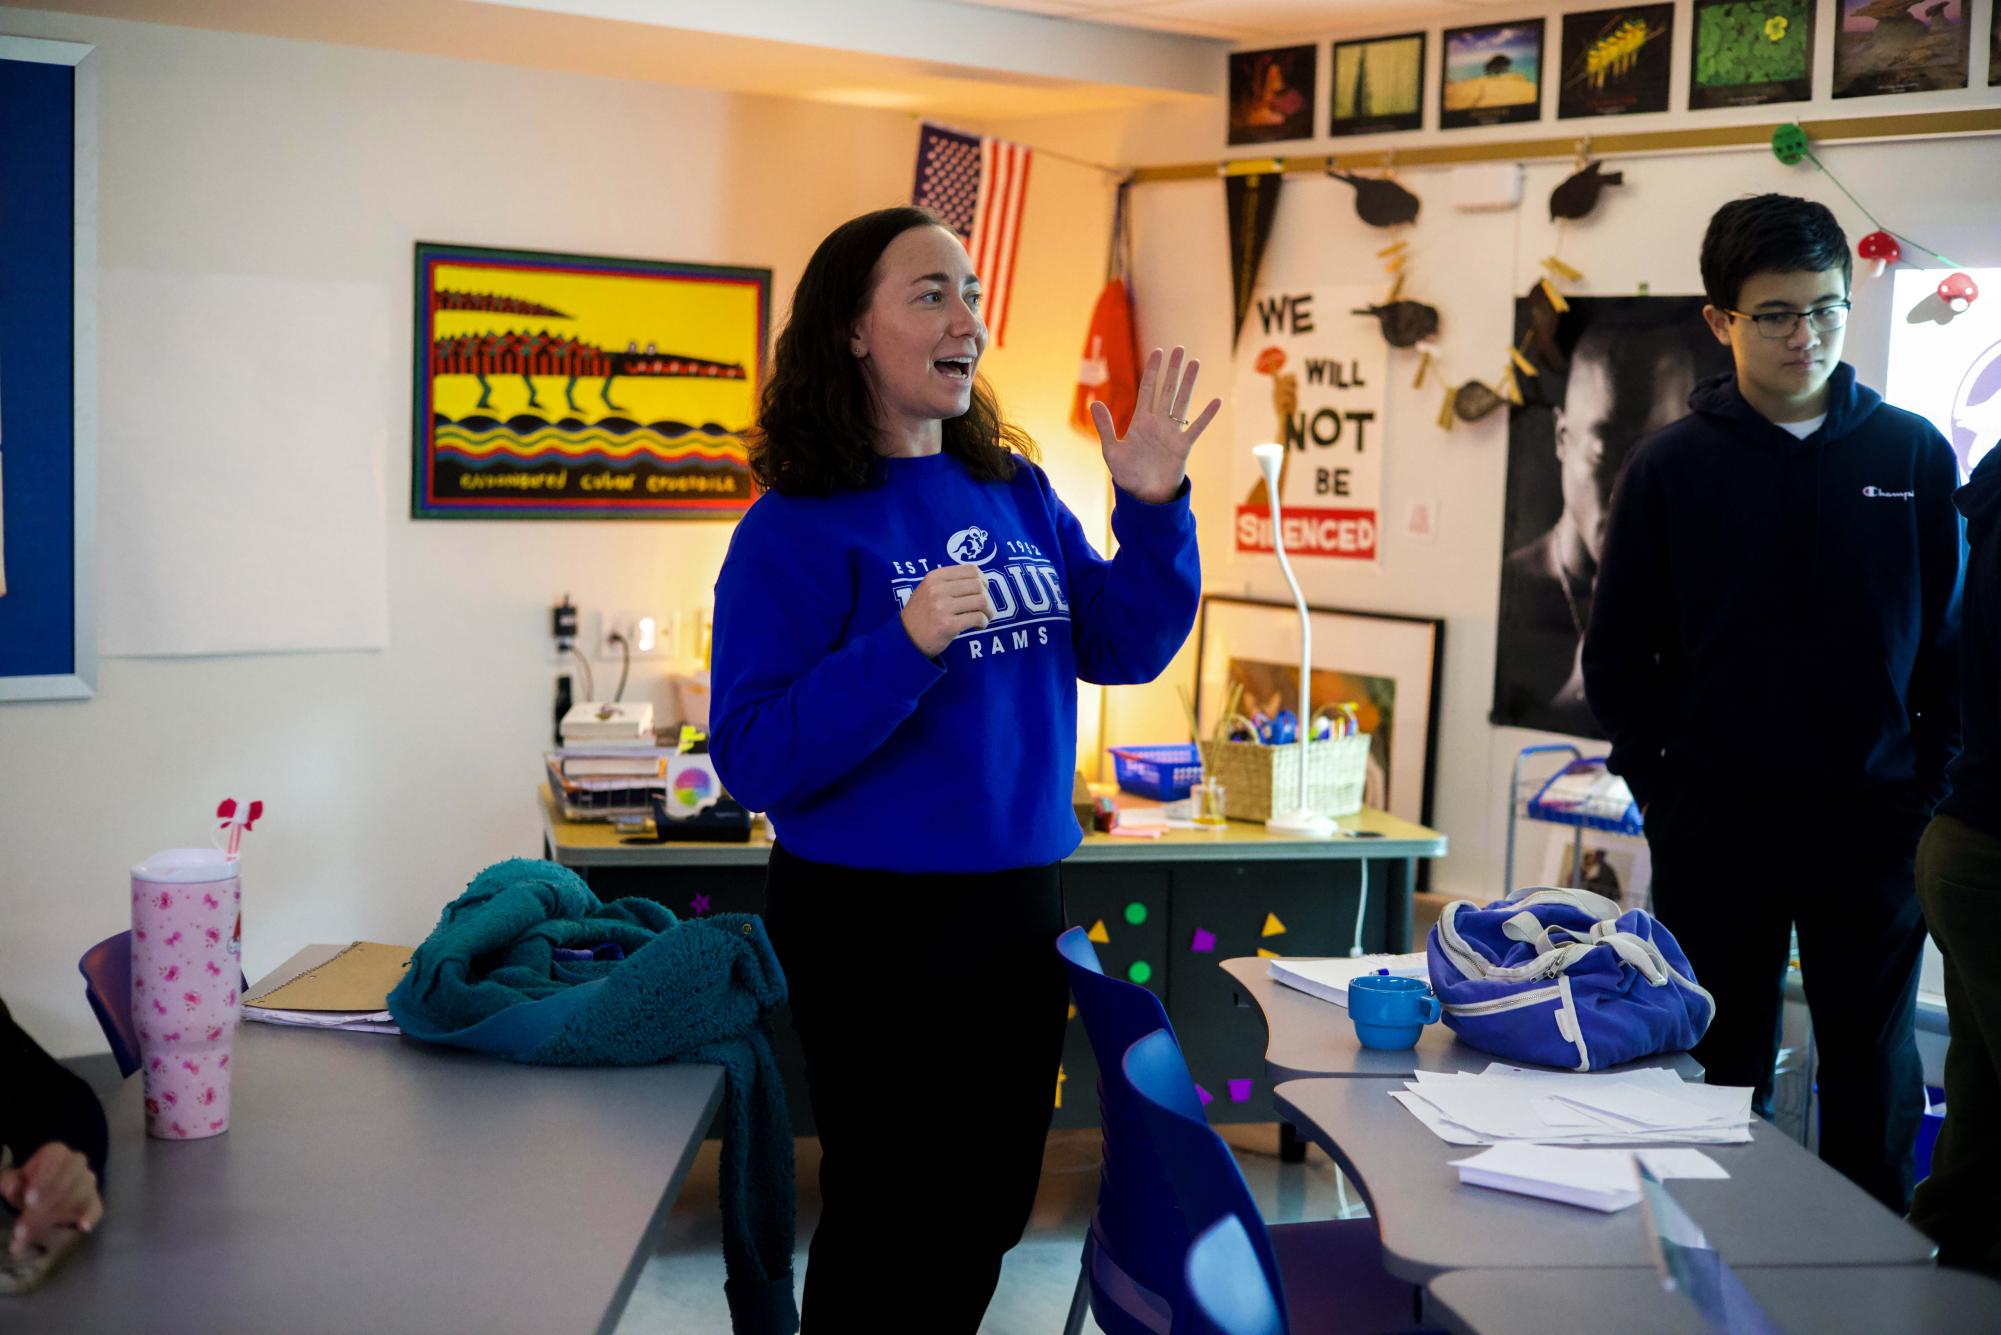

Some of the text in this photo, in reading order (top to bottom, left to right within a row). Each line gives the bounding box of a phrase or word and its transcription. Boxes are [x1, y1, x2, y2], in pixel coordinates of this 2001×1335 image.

[1256, 294, 1314, 335] WE
[1305, 358, 1366, 388] WILL
[1284, 408, 1375, 452] NOT
[1315, 467, 1352, 497] BE
[1862, 486, 1915, 501] Champi
[968, 626, 1048, 659] RAMS
